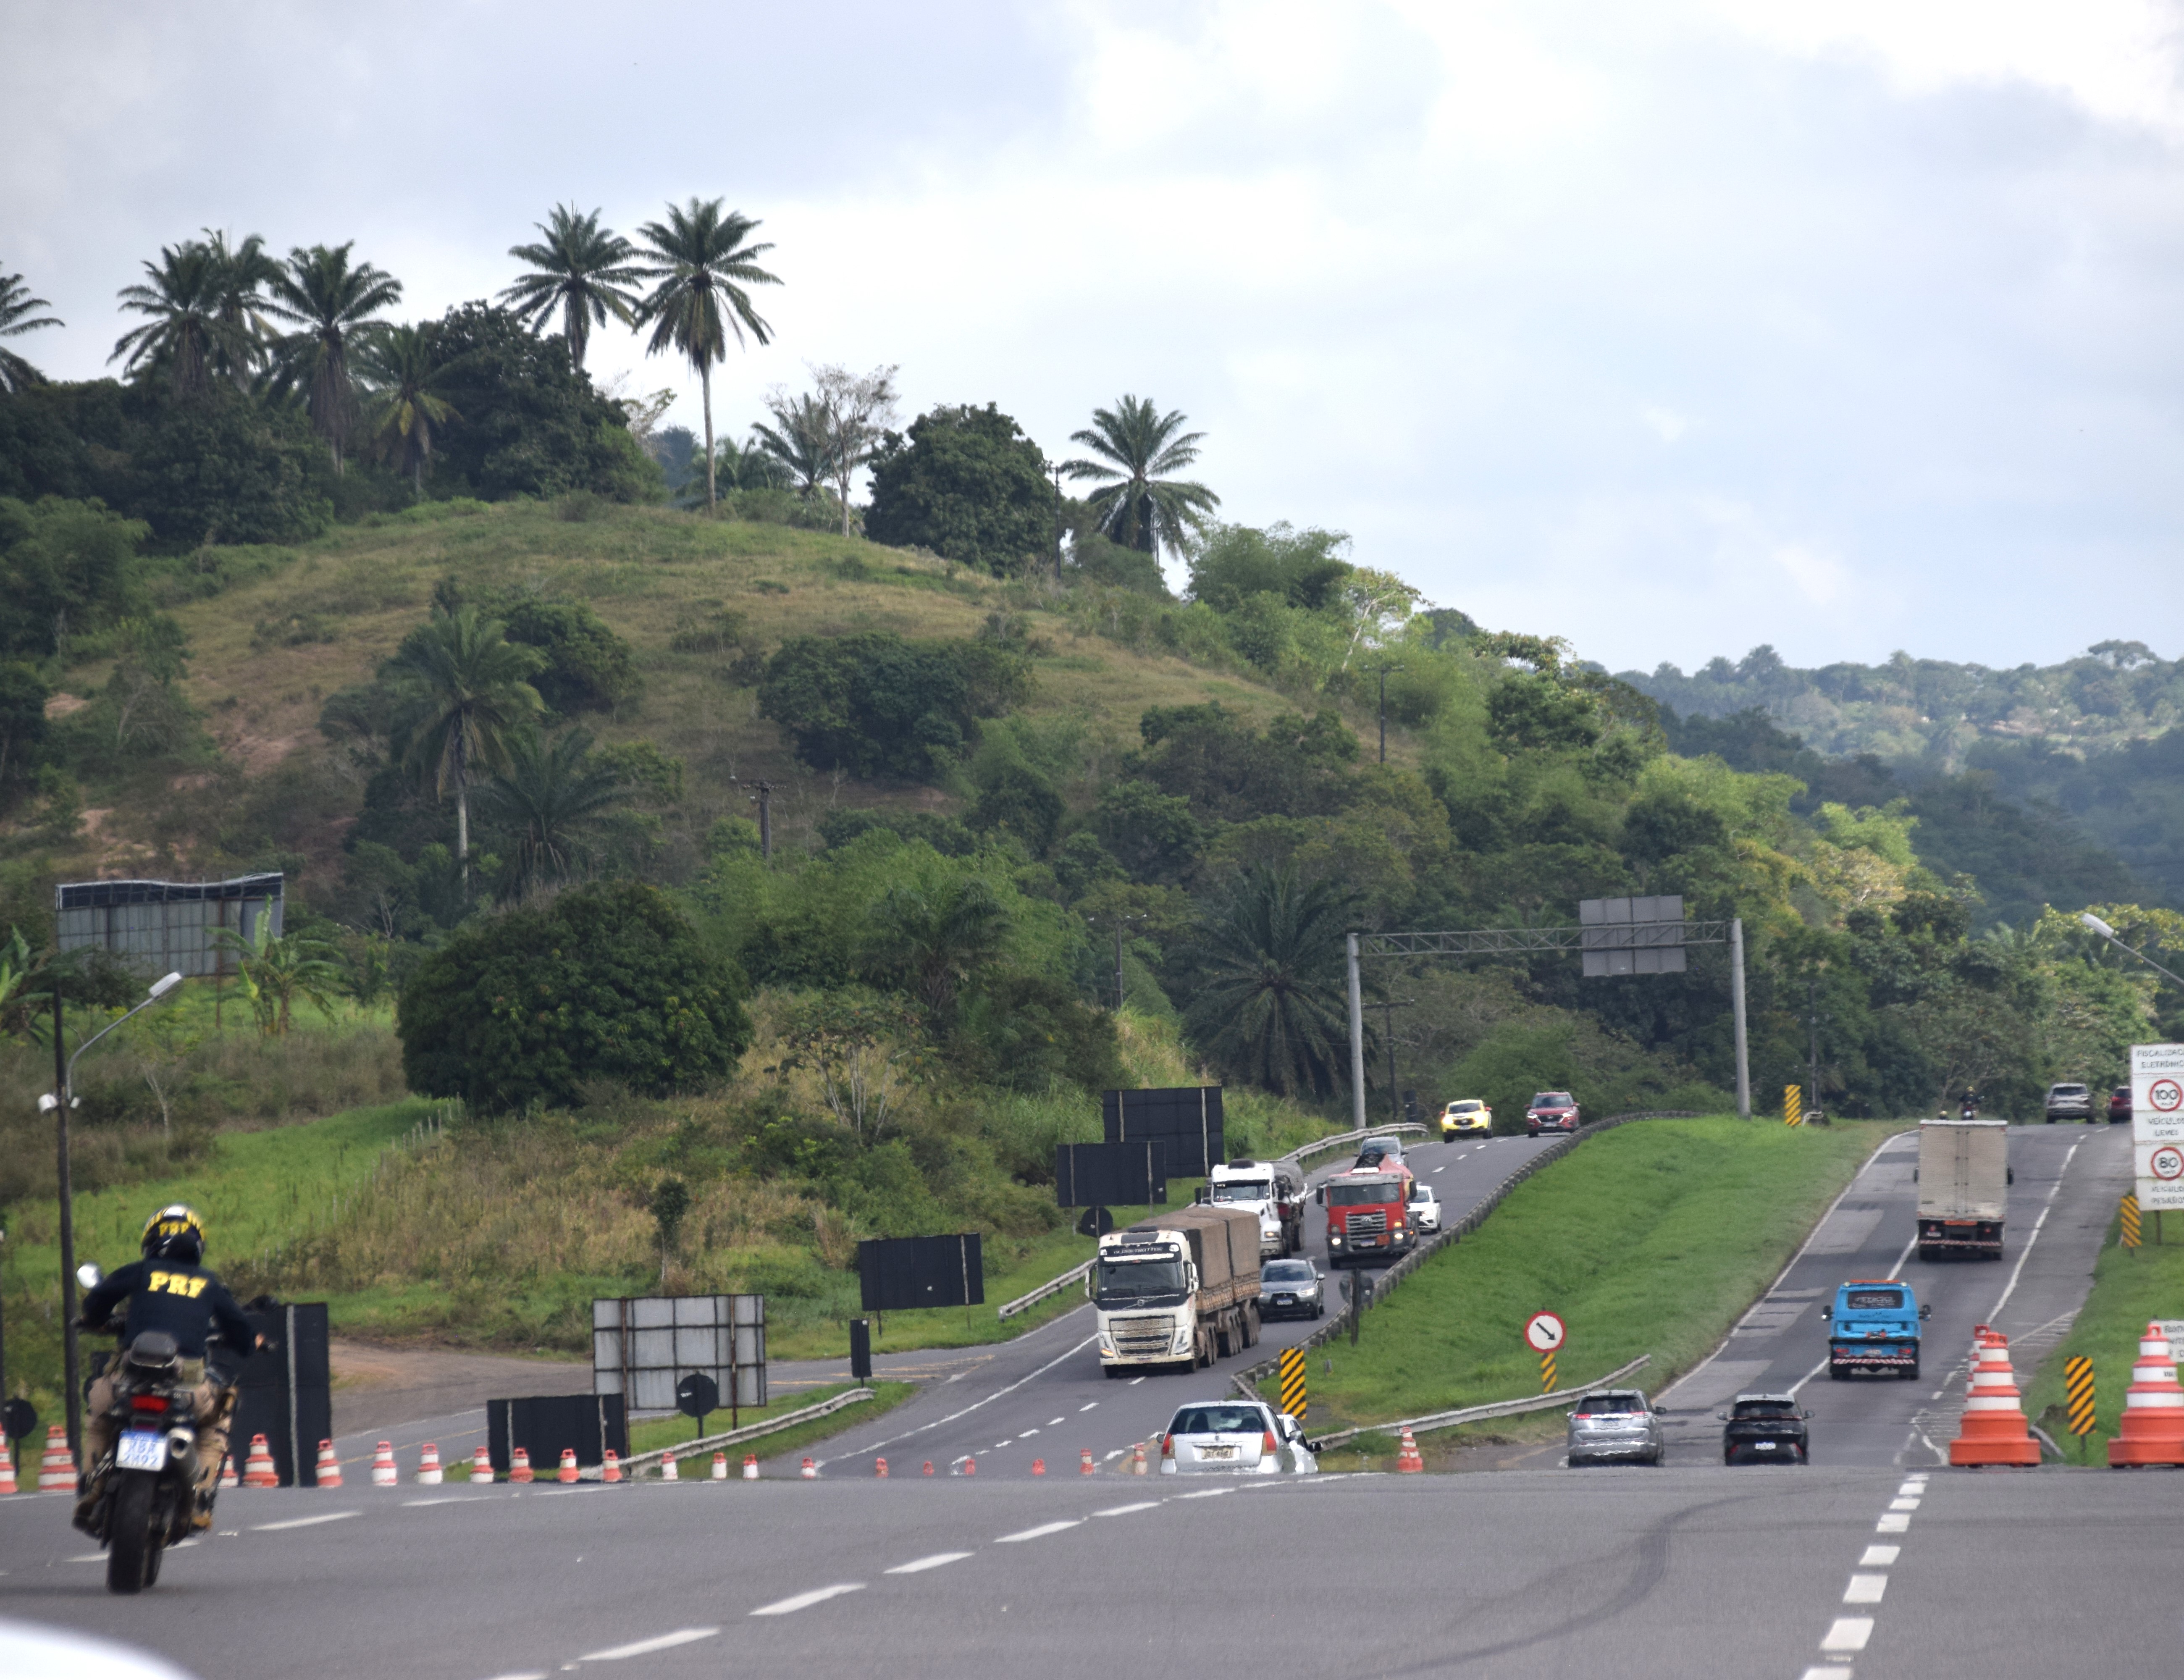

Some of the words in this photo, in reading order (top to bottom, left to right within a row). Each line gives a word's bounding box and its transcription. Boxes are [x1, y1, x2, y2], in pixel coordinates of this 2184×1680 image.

[2155, 1089, 2178, 1100] 100
[2159, 1157, 2178, 1168] 80
[147, 1270, 208, 1299] PRF
